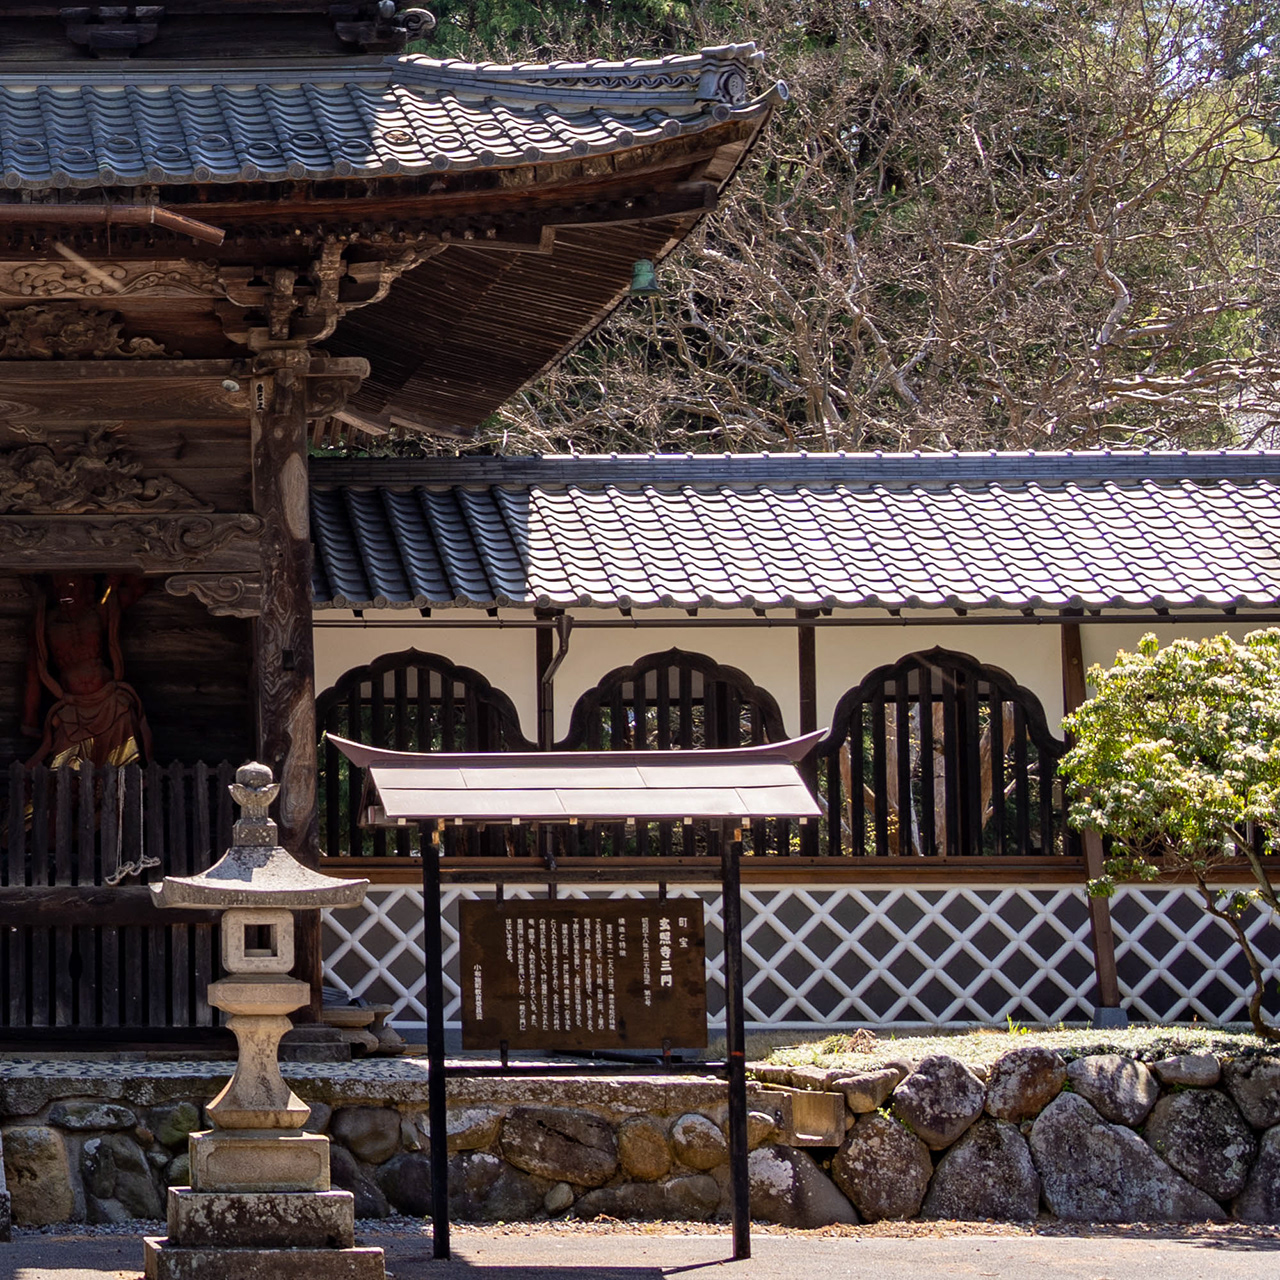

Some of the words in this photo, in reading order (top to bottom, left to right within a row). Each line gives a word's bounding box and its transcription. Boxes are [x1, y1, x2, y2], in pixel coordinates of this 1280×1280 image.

[659, 917, 673, 987] 玄照寺三門
